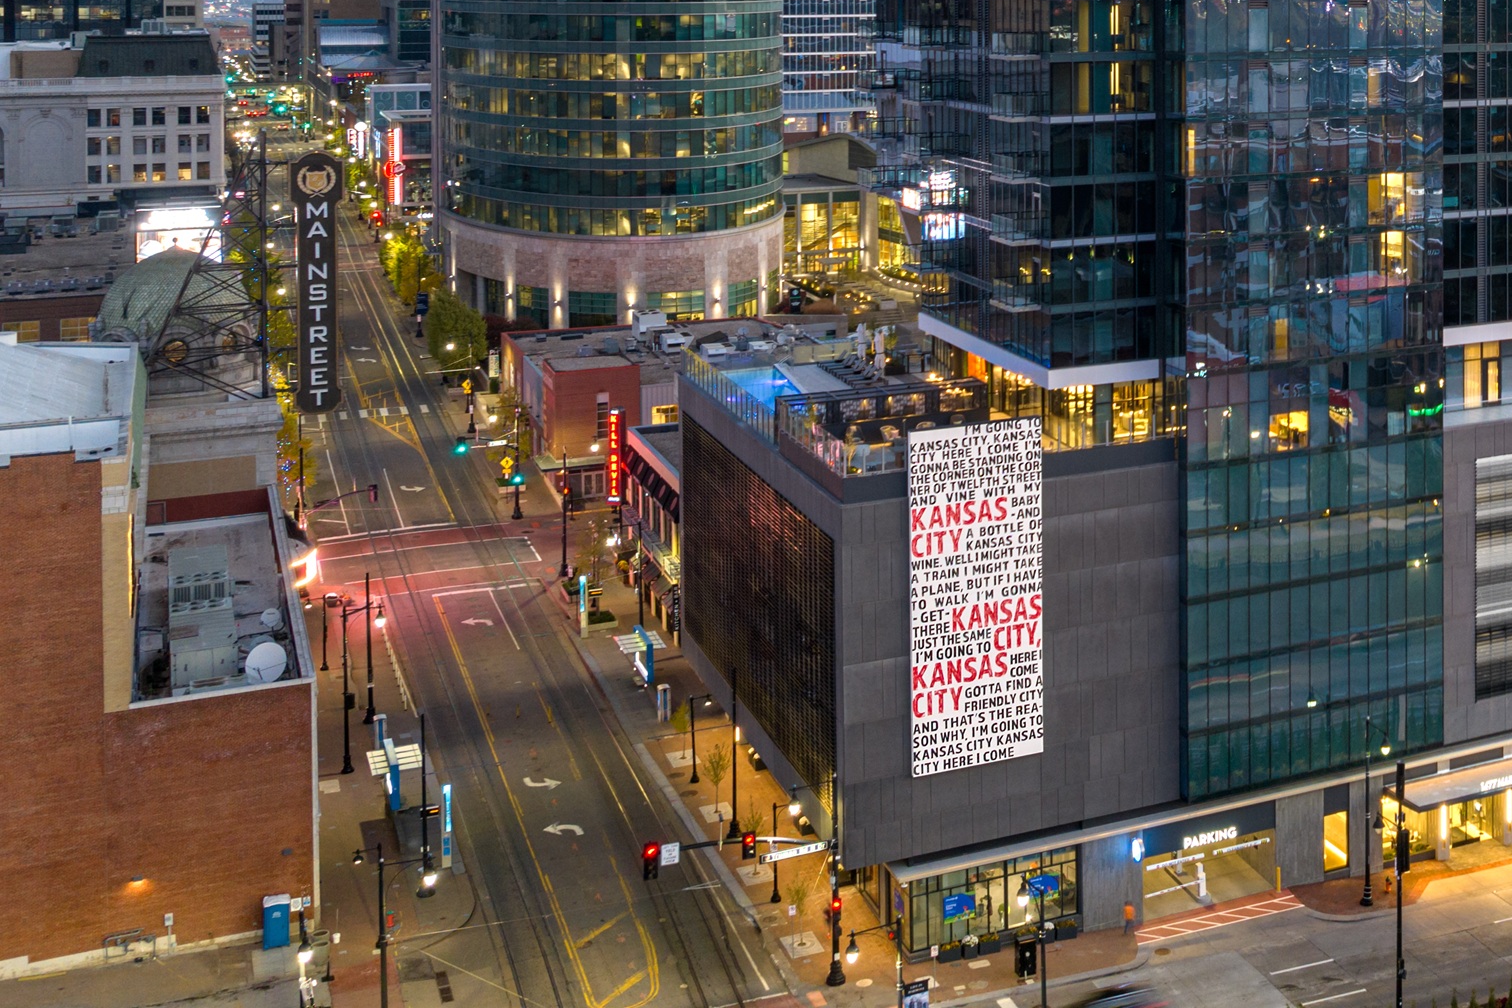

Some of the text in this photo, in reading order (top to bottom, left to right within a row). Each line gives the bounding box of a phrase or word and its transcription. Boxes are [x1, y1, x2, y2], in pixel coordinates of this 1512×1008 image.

[610, 415, 618, 449] KILL
[965, 417, 1041, 435] I'M GOING TO
[910, 439, 958, 455] KANSAS
[994, 429, 1041, 445] KANSAS
[910, 452, 935, 464] CITY
[943, 448, 971, 459] HERE
[988, 443, 1018, 454] COME
[1025, 440, 1041, 450] I'M
[610, 454, 618, 496] DEVIL
[910, 474, 930, 485] THE
[933, 469, 974, 482] CORNER
[978, 467, 992, 477] ON
[996, 464, 1015, 474] THE
[911, 451, 1040, 474] GONNA BE STANDING ON
[910, 470, 1042, 496] NER OF TWELFTH STREET
[910, 482, 1041, 507] AND VINE WITH MY
[912, 497, 1007, 531] KANSAS
[1012, 495, 1039, 507] BABY
[966, 518, 1043, 538] A BOTTLE OF
[967, 531, 1042, 551] KANSAS CITY
[912, 528, 962, 557] CITY
[911, 558, 942, 571] WINE.
[945, 554, 973, 566] WELL
[981, 548, 1014, 561] MIGHT
[1016, 543, 1042, 555] TAKE
[911, 574, 918, 584] A
[924, 568, 959, 581] TRAIN
[973, 561, 1008, 575] MIGHT
[1014, 556, 1042, 569] TAKE
[911, 588, 918, 598] A
[922, 581, 963, 596] PLANE,
[967, 577, 990, 589] BUT
[994, 575, 1003, 585] IF
[1014, 569, 1042, 582] HAVE
[911, 581, 1043, 610] TO WALK I'M GONNA
[953, 595, 1042, 632] KANSAS
[912, 628, 991, 651] JUST THE SAME
[913, 622, 949, 638] THERE
[916, 641, 990, 663] I'M GOING TO
[1011, 651, 1037, 664] HERE
[913, 652, 1007, 690] KANSAS
[1010, 663, 1038, 677] COME
[965, 676, 1043, 698] GOTTA FIND A
[965, 688, 1043, 712] FRIENDLY CITY
[913, 686, 962, 718] CITY
[913, 703, 1042, 735] AND THAT'S THE REA-
[913, 734, 937, 748] SON
[972, 725, 988, 737] I'M
[991, 717, 1026, 733] GOING
[1030, 715, 1043, 730] TO
[913, 727, 1044, 762] KANSAS CITY KANSAS
[914, 761, 939, 775] CITY
[944, 754, 973, 769] HERE
[984, 747, 1014, 764] COME
[1183, 826, 1238, 849] PARKING
